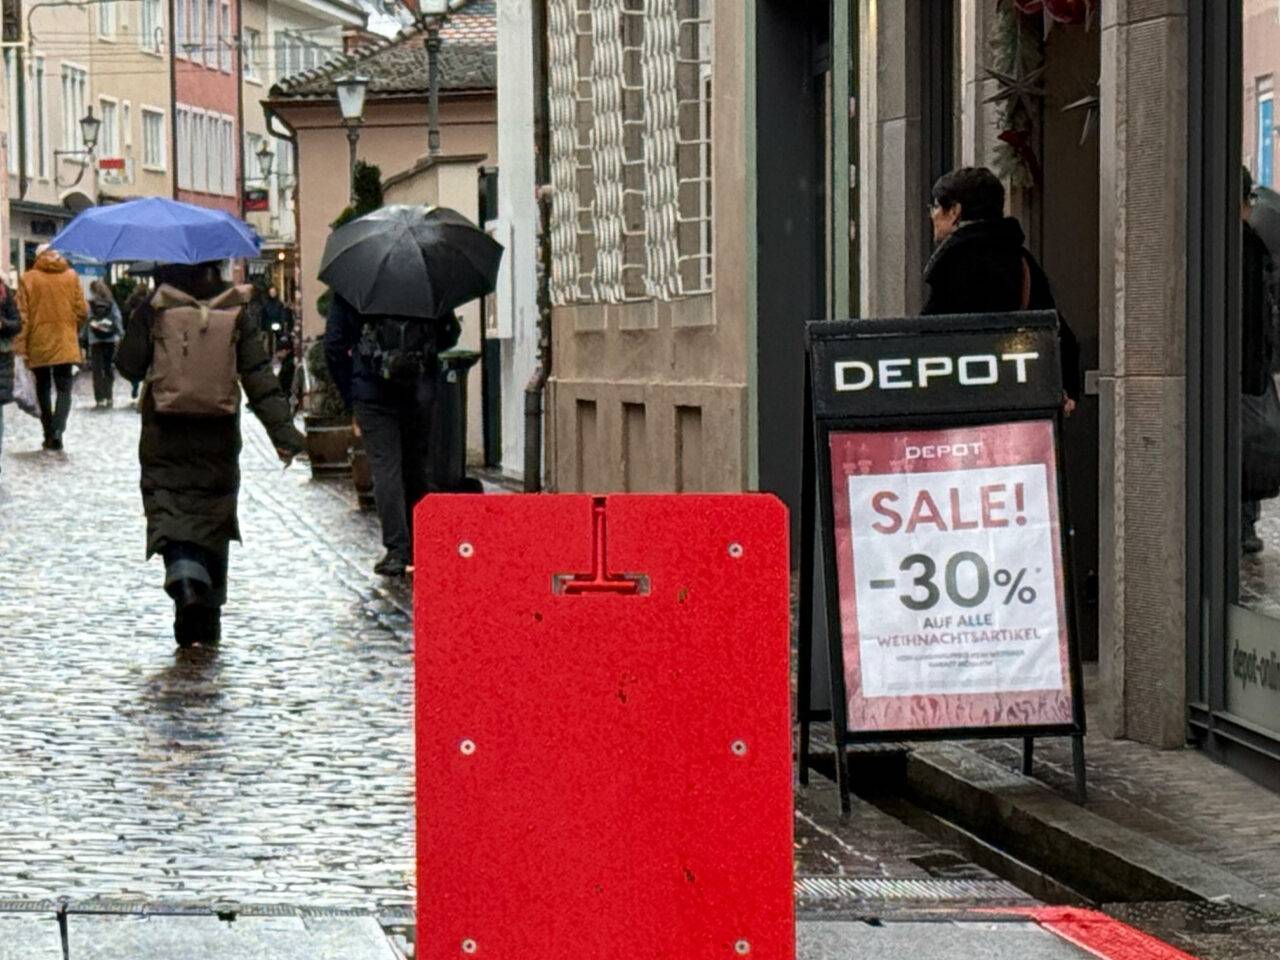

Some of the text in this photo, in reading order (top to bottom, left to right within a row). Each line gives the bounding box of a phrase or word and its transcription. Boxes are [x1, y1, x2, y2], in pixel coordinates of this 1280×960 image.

[834, 352, 1039, 392] DEPOT
[905, 442, 982, 460] DEPOT
[871, 483, 1028, 535] SALE!
[923, 613, 993, 629] AUF ALLE
[877, 627, 1042, 648] WEIHNACHTSARTIKEL
